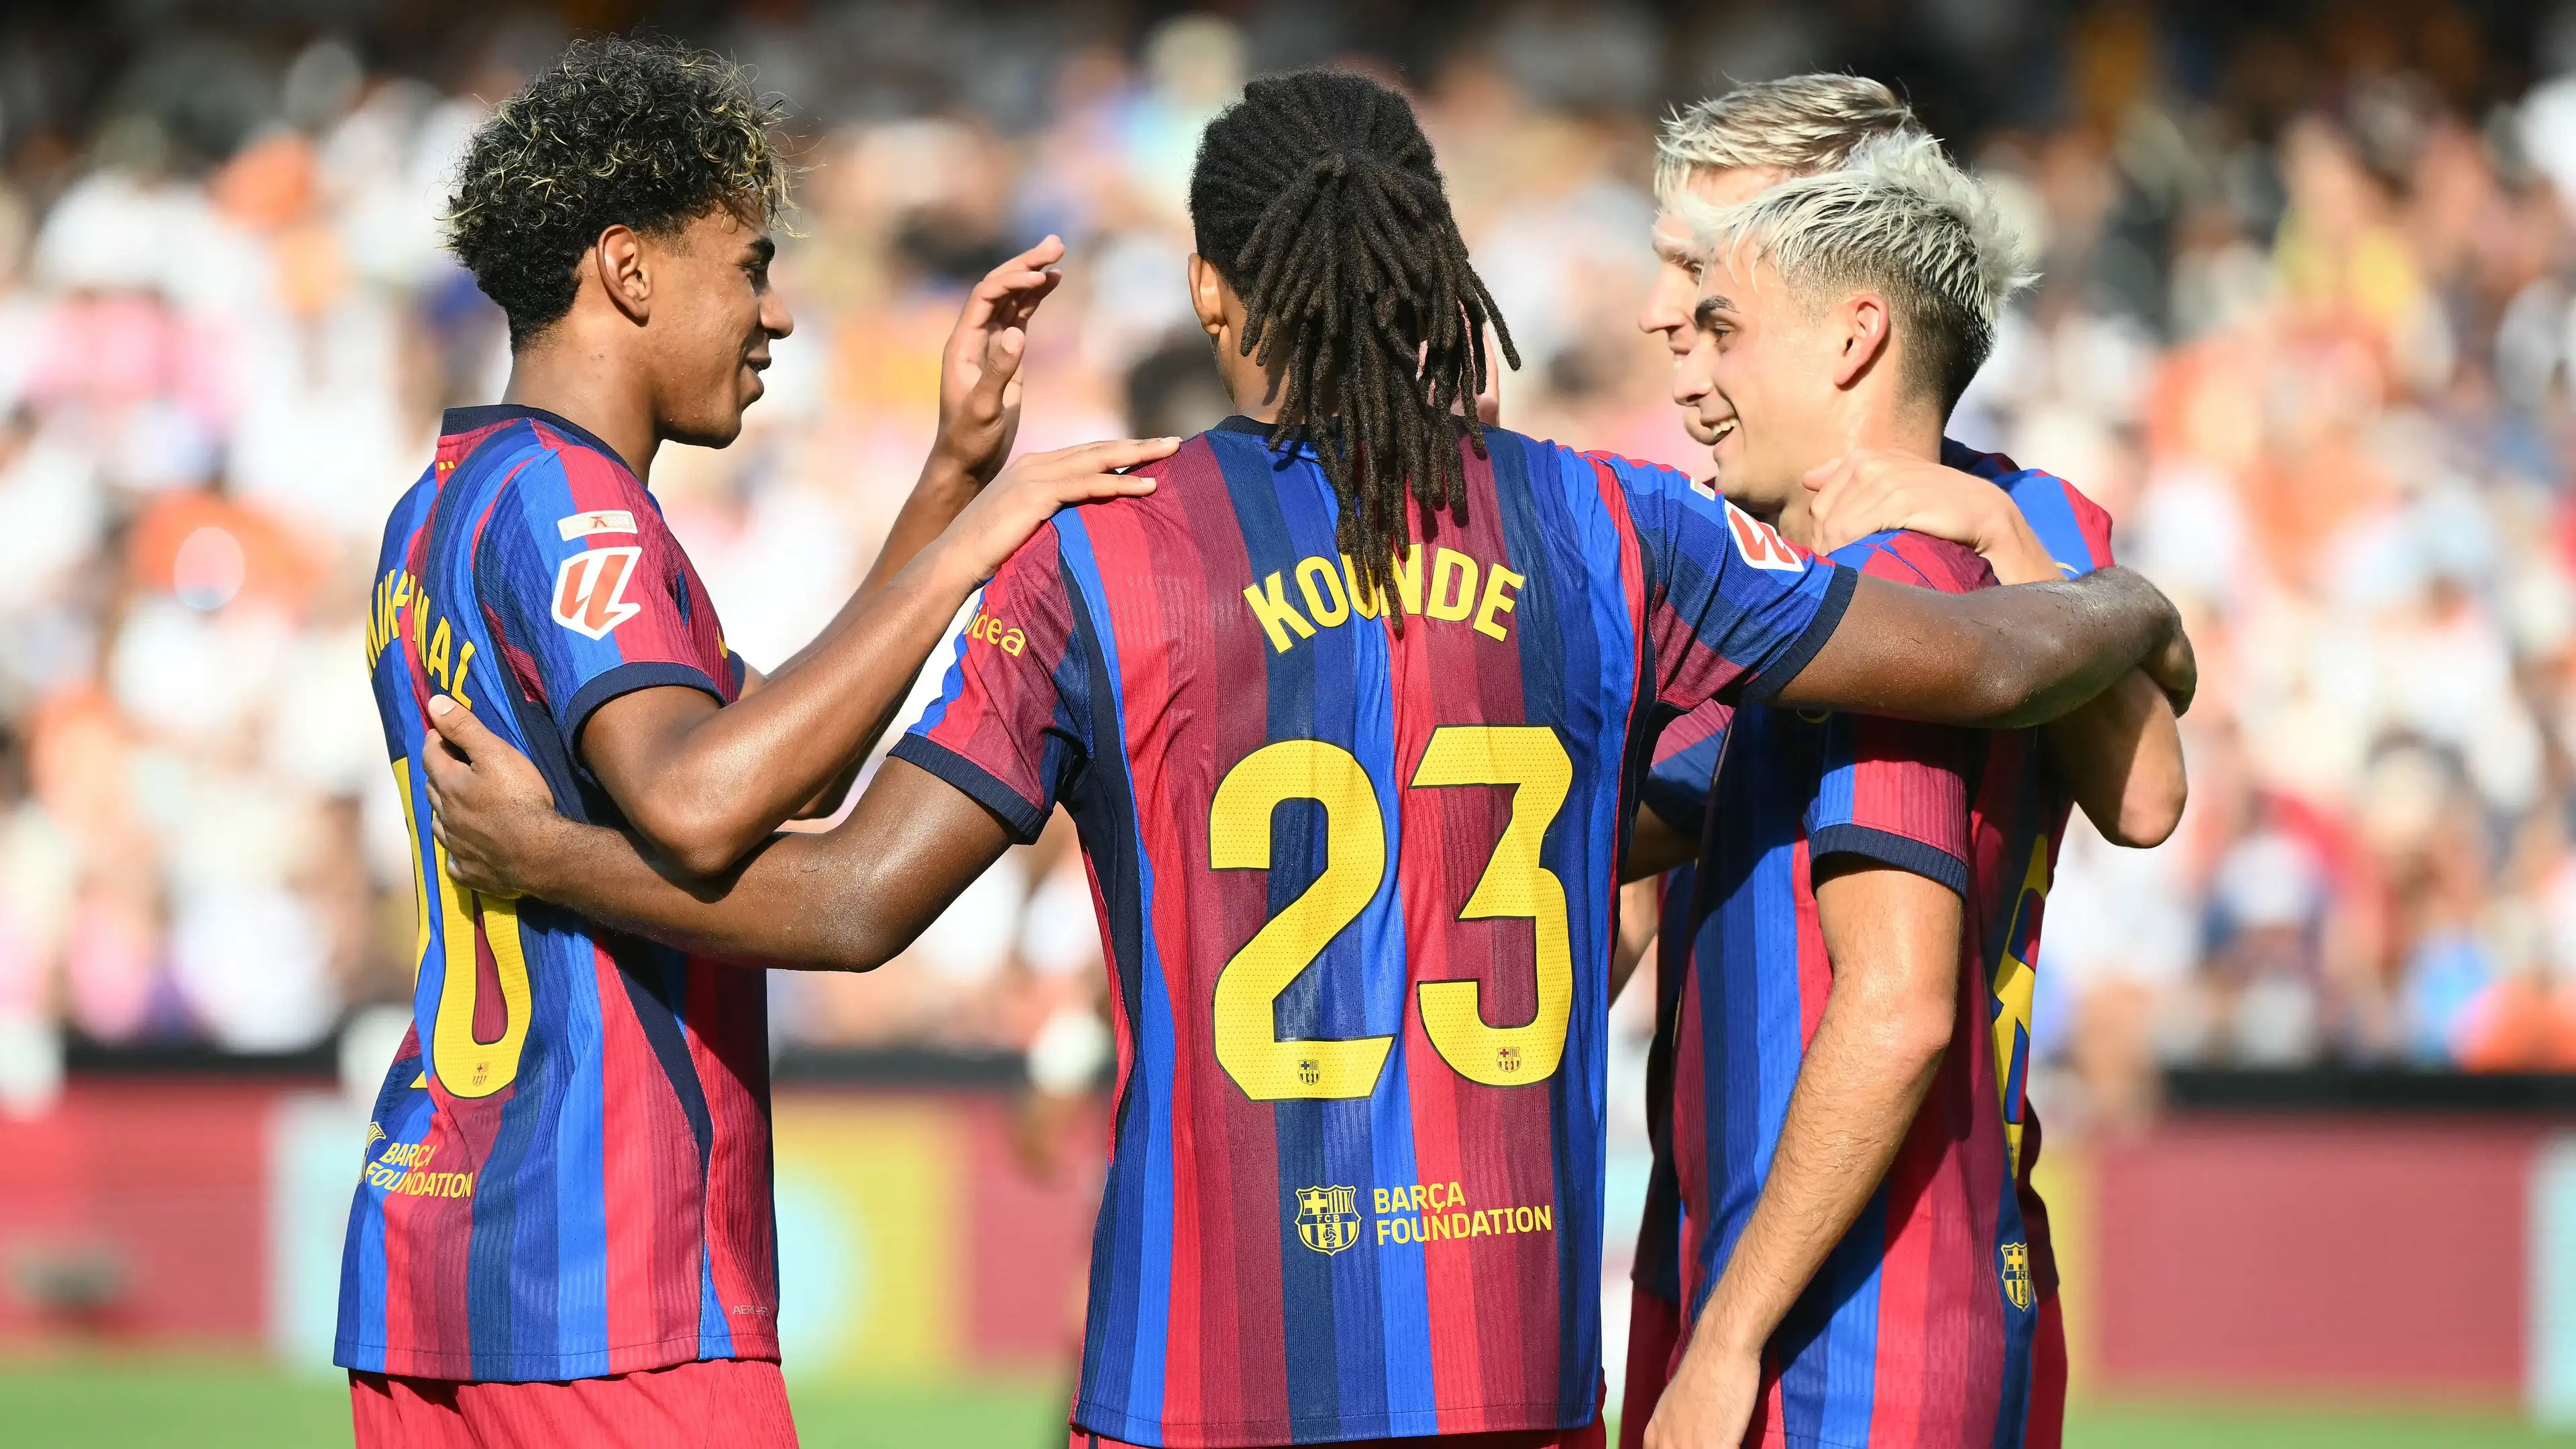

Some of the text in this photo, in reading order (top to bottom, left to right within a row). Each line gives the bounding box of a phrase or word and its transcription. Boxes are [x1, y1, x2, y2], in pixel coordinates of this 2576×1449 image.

[1242, 543, 1525, 654] KOUNDE
[1209, 724, 1573, 1102] 23
[379, 1142, 437, 1172] BARÇA
[365, 1161, 474, 1198] FOUNDATION
[1373, 1181, 1466, 1214] BARÇA
[1316, 1214, 1340, 1224] FCB
[1377, 1205, 1552, 1246] FOUNDATION
